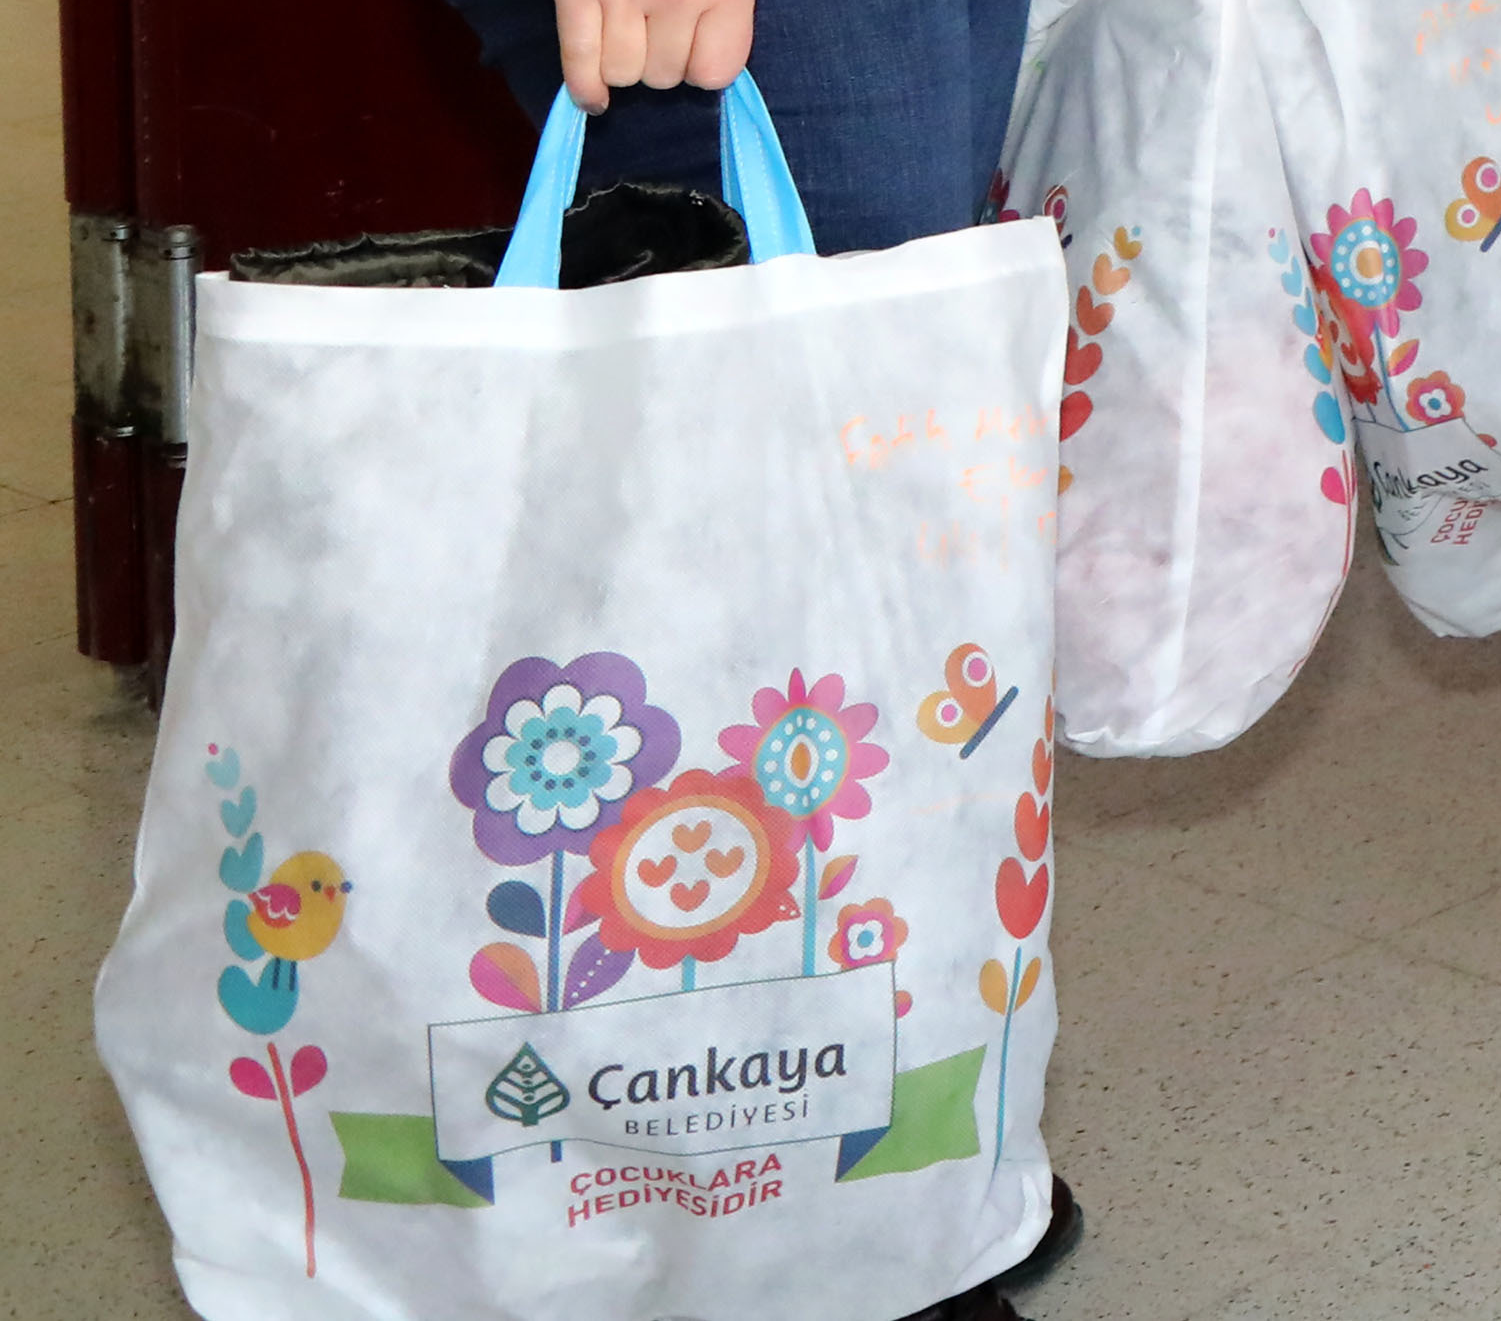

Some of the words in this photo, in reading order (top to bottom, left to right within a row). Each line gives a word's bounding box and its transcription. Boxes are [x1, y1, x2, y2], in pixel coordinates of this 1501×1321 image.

[587, 1041, 849, 1111] Çankaya
[624, 1093, 811, 1138] BELEDİYESİ
[568, 1152, 785, 1200] ÇOCUKLARA
[566, 1177, 786, 1229] HEDİYESİDİR
